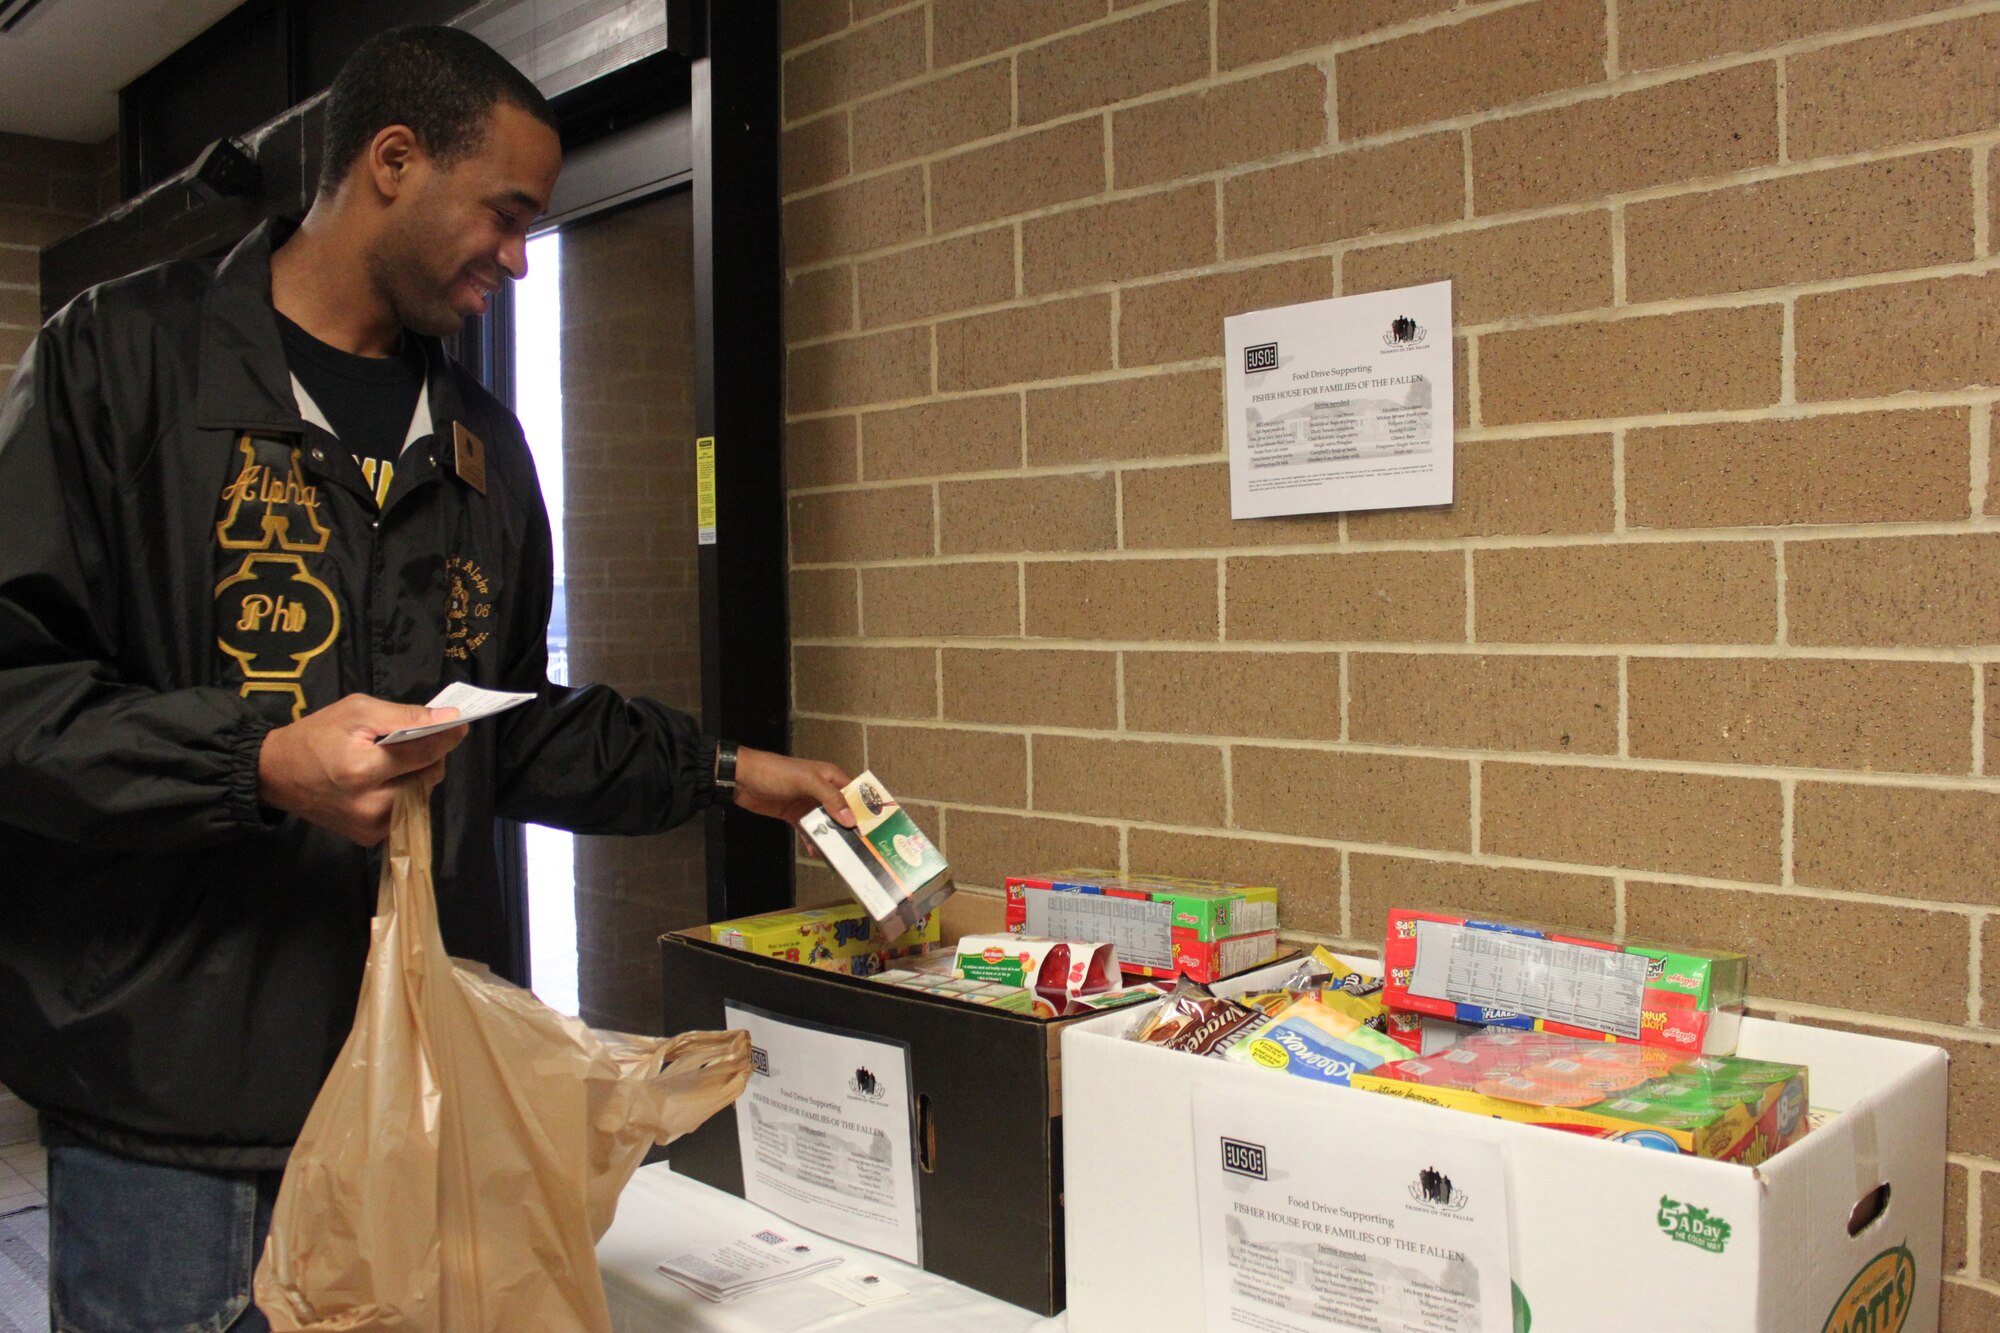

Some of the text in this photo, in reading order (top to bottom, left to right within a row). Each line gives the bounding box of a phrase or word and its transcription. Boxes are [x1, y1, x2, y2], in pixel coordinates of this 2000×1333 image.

[1252, 374, 1423, 402] FISHER HOUSE FOR FAMILIES OF THE FALLEN
[1292, 365, 1372, 381] Food Drive Supporting
[831, 916, 870, 948] Pak
[1176, 1006, 1246, 1056] Nugget
[1277, 1030, 1355, 1081] Kleenex
[781, 1088, 842, 1114] Food Drive Supporting
[771, 1100, 788, 1112] HOUSE
[790, 1106, 800, 1116] FOR
[802, 1110, 830, 1125] FAMILIES
[832, 1118, 840, 1127] OF
[841, 1121, 855, 1131] THE
[857, 1123, 884, 1138] FALLEN
[1288, 1196, 1394, 1228] Food Drive Supporting
[1453, 1214, 1474, 1222] FALLEN
[1660, 1206, 1721, 1242] 5 A Day
[1234, 1202, 1465, 1262] FISHER HOUSE FOR FAMILIES OF THE FALLEN
[1675, 1230, 1686, 1240] THE
[1318, 1244, 1366, 1262] Items needed
